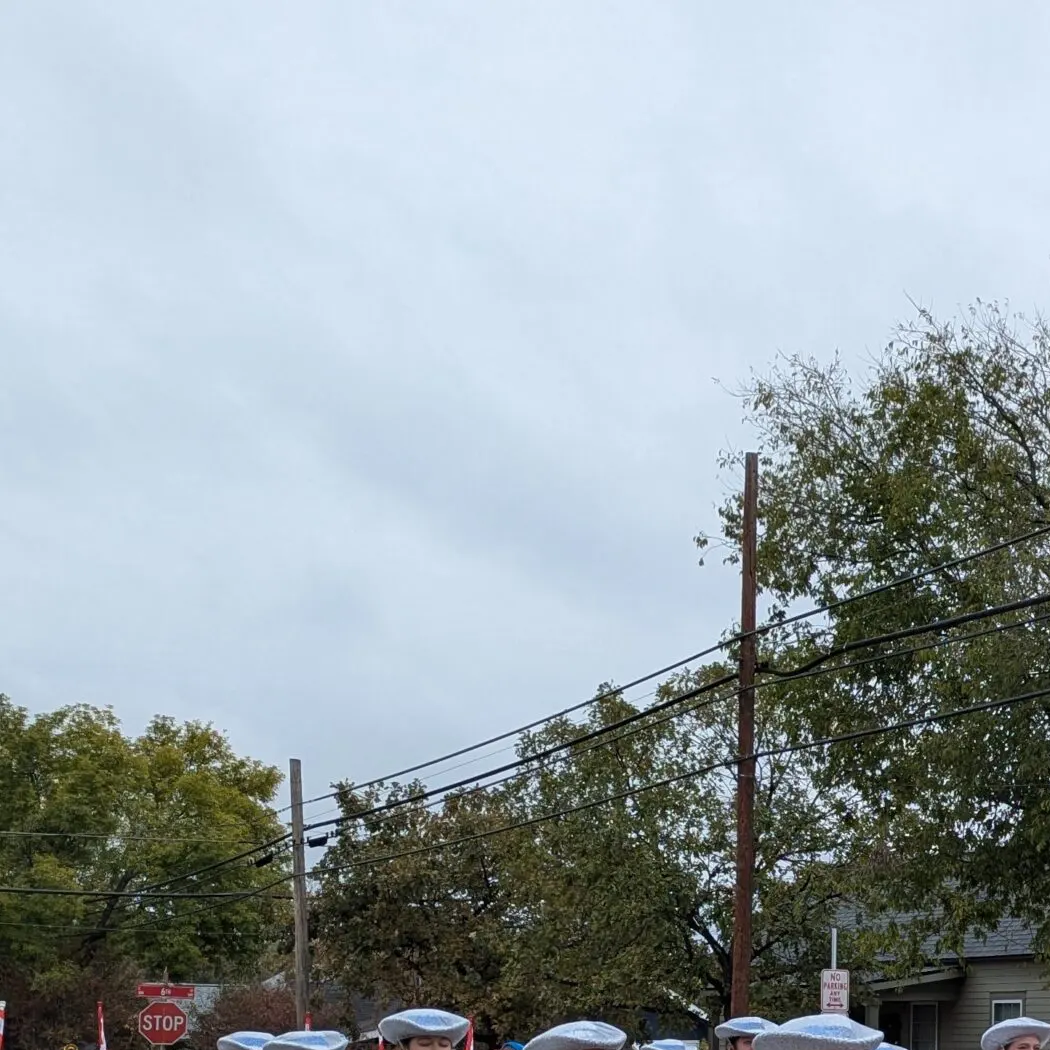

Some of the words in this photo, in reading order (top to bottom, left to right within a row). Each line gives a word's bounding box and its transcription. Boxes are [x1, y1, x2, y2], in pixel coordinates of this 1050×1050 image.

[830, 972, 841, 981] NO
[823, 982, 848, 990] PARKING
[142, 1015, 184, 1031] STOP
